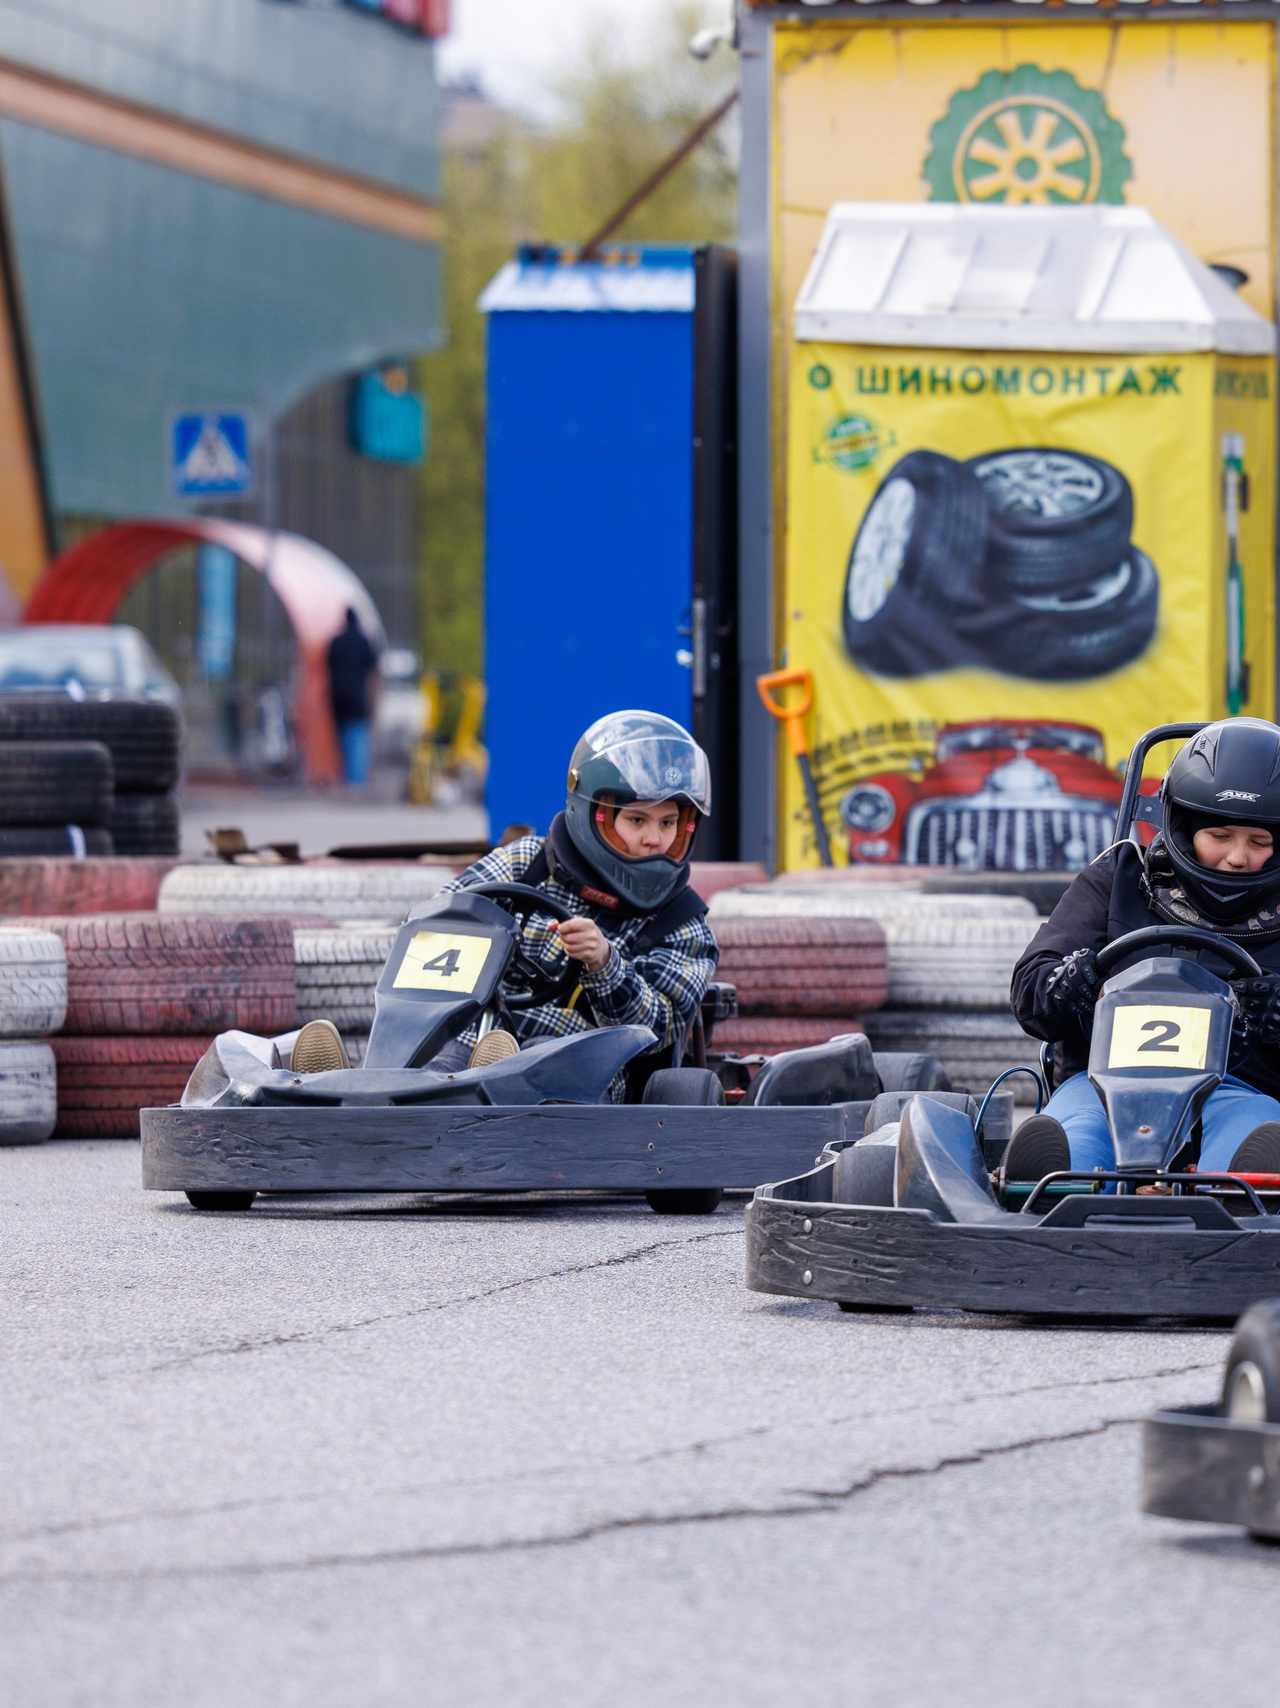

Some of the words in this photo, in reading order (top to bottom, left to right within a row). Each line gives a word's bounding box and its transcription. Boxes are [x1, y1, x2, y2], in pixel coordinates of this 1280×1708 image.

[856, 366, 1181, 396] ШИНОМОНТАЖ
[422, 948, 461, 977] 4
[1137, 1020, 1181, 1052] 2
